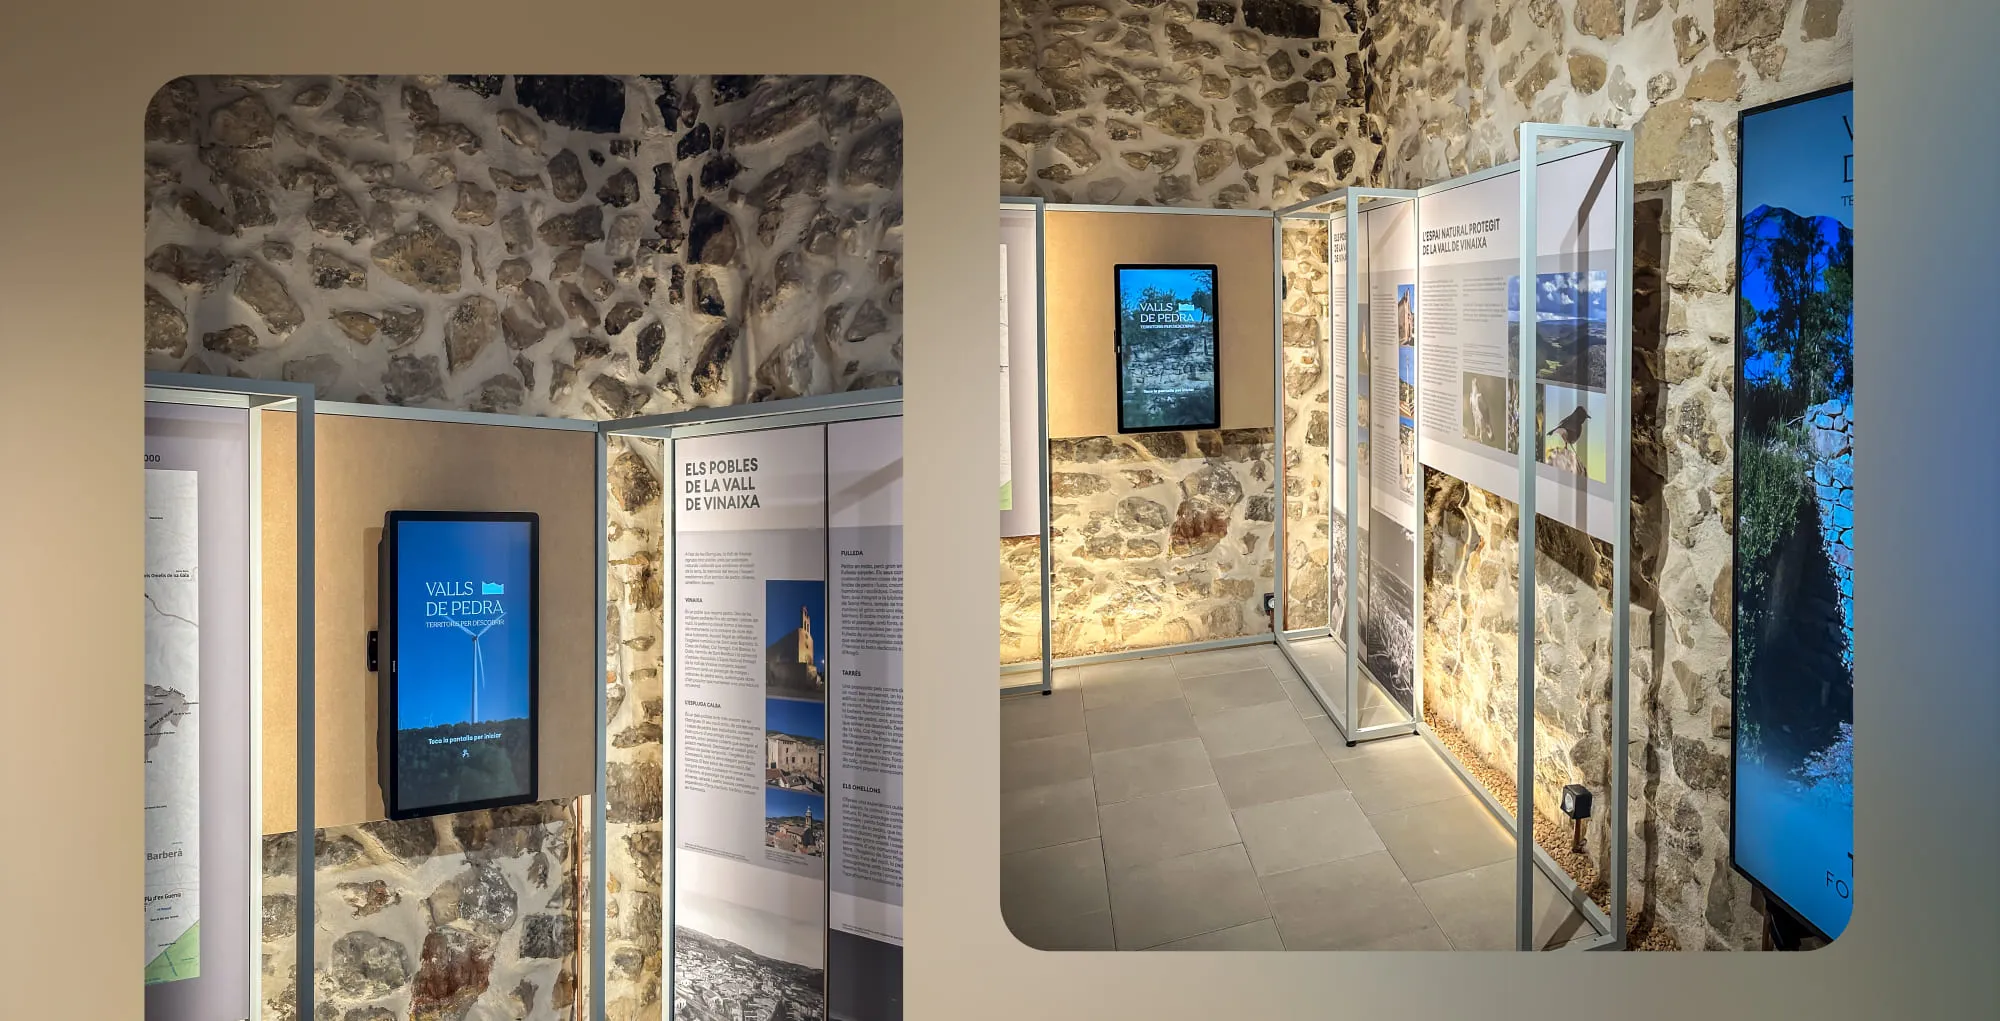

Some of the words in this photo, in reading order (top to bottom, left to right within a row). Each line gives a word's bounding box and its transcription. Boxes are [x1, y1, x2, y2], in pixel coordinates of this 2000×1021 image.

[1422, 229, 1441, 242] L'ESPAI
[1441, 224, 1468, 239] NATURAL
[1469, 218, 1500, 235] PROTEGIT
[1422, 244, 1430, 255] DE
[1430, 243, 1437, 255] LA
[1437, 241, 1451, 253] VALL
[1452, 240, 1459, 252] DE
[1460, 236, 1487, 251] VINAIXA
[1140, 302, 1173, 312] VALLS
[1140, 313, 1155, 323] DE
[1158, 313, 1195, 322] PEDRA
[686, 461, 707, 476] ELS
[709, 457, 758, 474] POBLES
[686, 480, 701, 493] DE
[704, 478, 720, 492] LA
[722, 476, 756, 491] VALL
[686, 497, 701, 511] DE
[703, 494, 760, 510] VINAIXA
[425, 581, 474, 596] VALLS
[426, 601, 448, 616] DE
[451, 599, 504, 615] PEDRA
[449, 735, 473, 745] pantalla
[474, 734, 483, 743] per
[484, 732, 502, 740] iniciar
